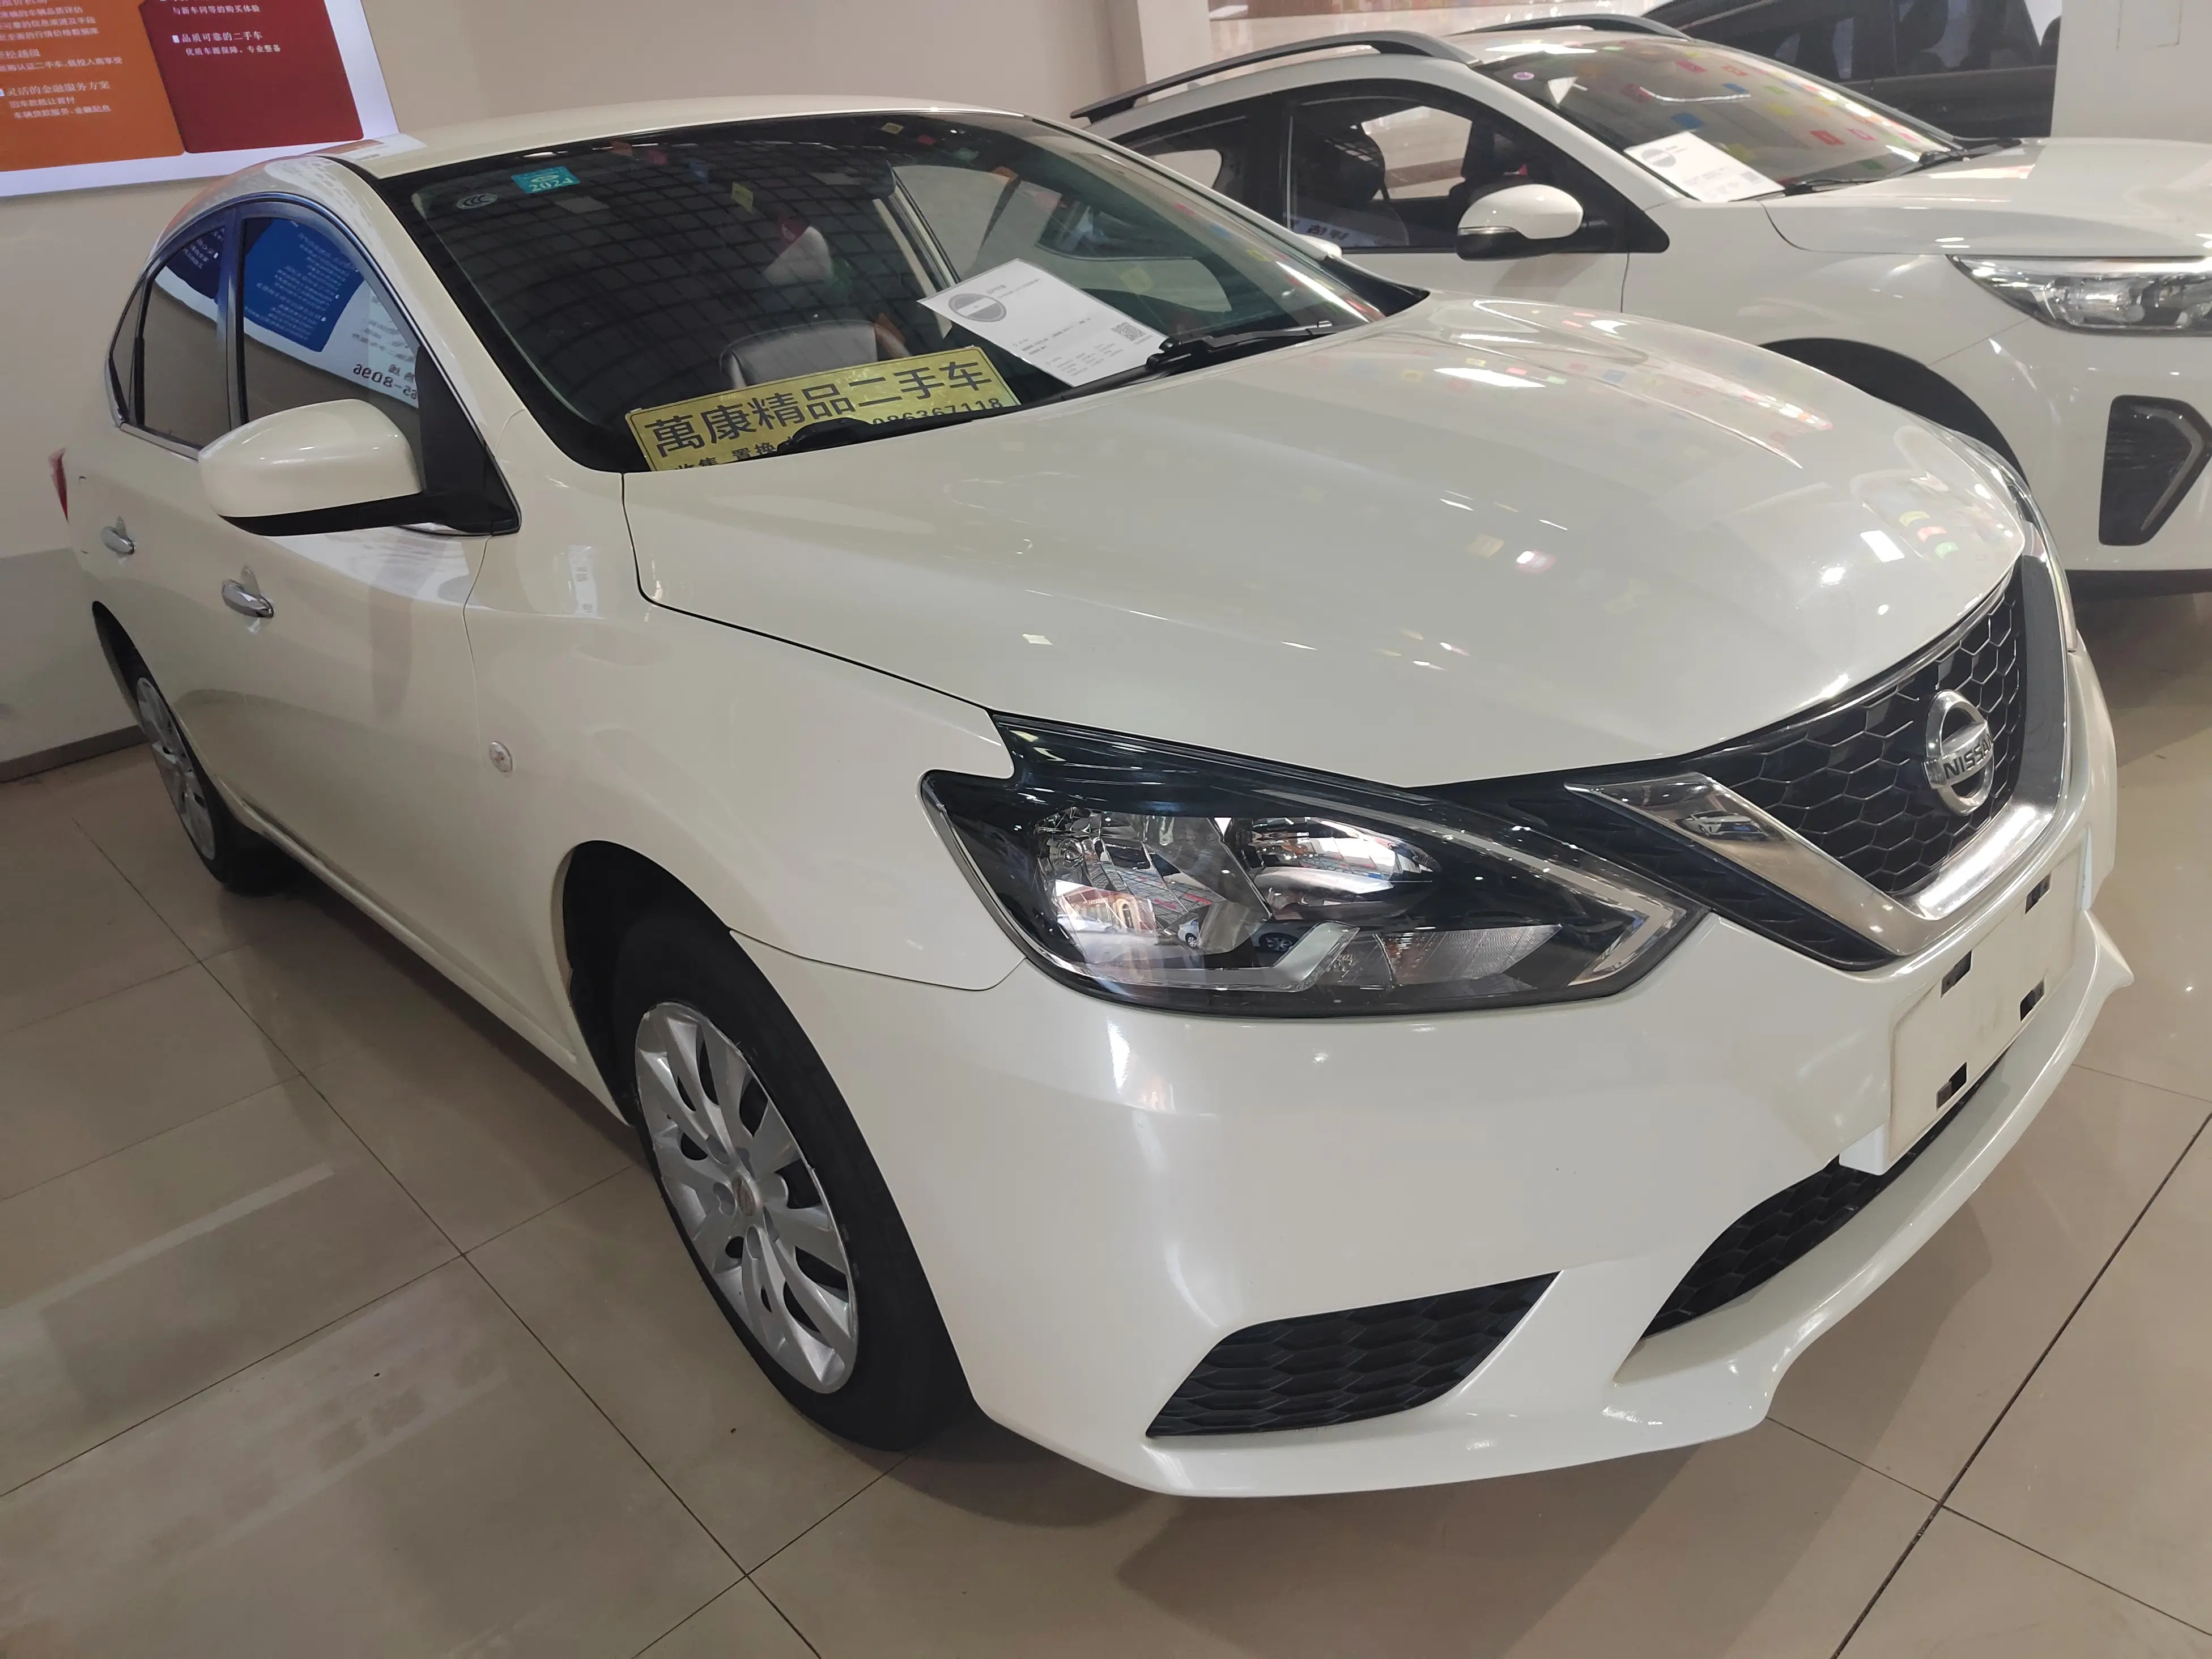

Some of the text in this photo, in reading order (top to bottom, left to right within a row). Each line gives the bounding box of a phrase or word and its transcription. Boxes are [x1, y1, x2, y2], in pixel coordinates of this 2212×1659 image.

[173, 5, 261, 15] 与新车同等的购买体验
[181, 31, 263, 43] 品质可靠的二手车
[6, 80, 110, 96] 灵活的金融服务方案
[528, 177, 573, 192] 2024
[644, 361, 993, 457] 萬康精品二手车
[1942, 733, 1993, 780] NISSAN
